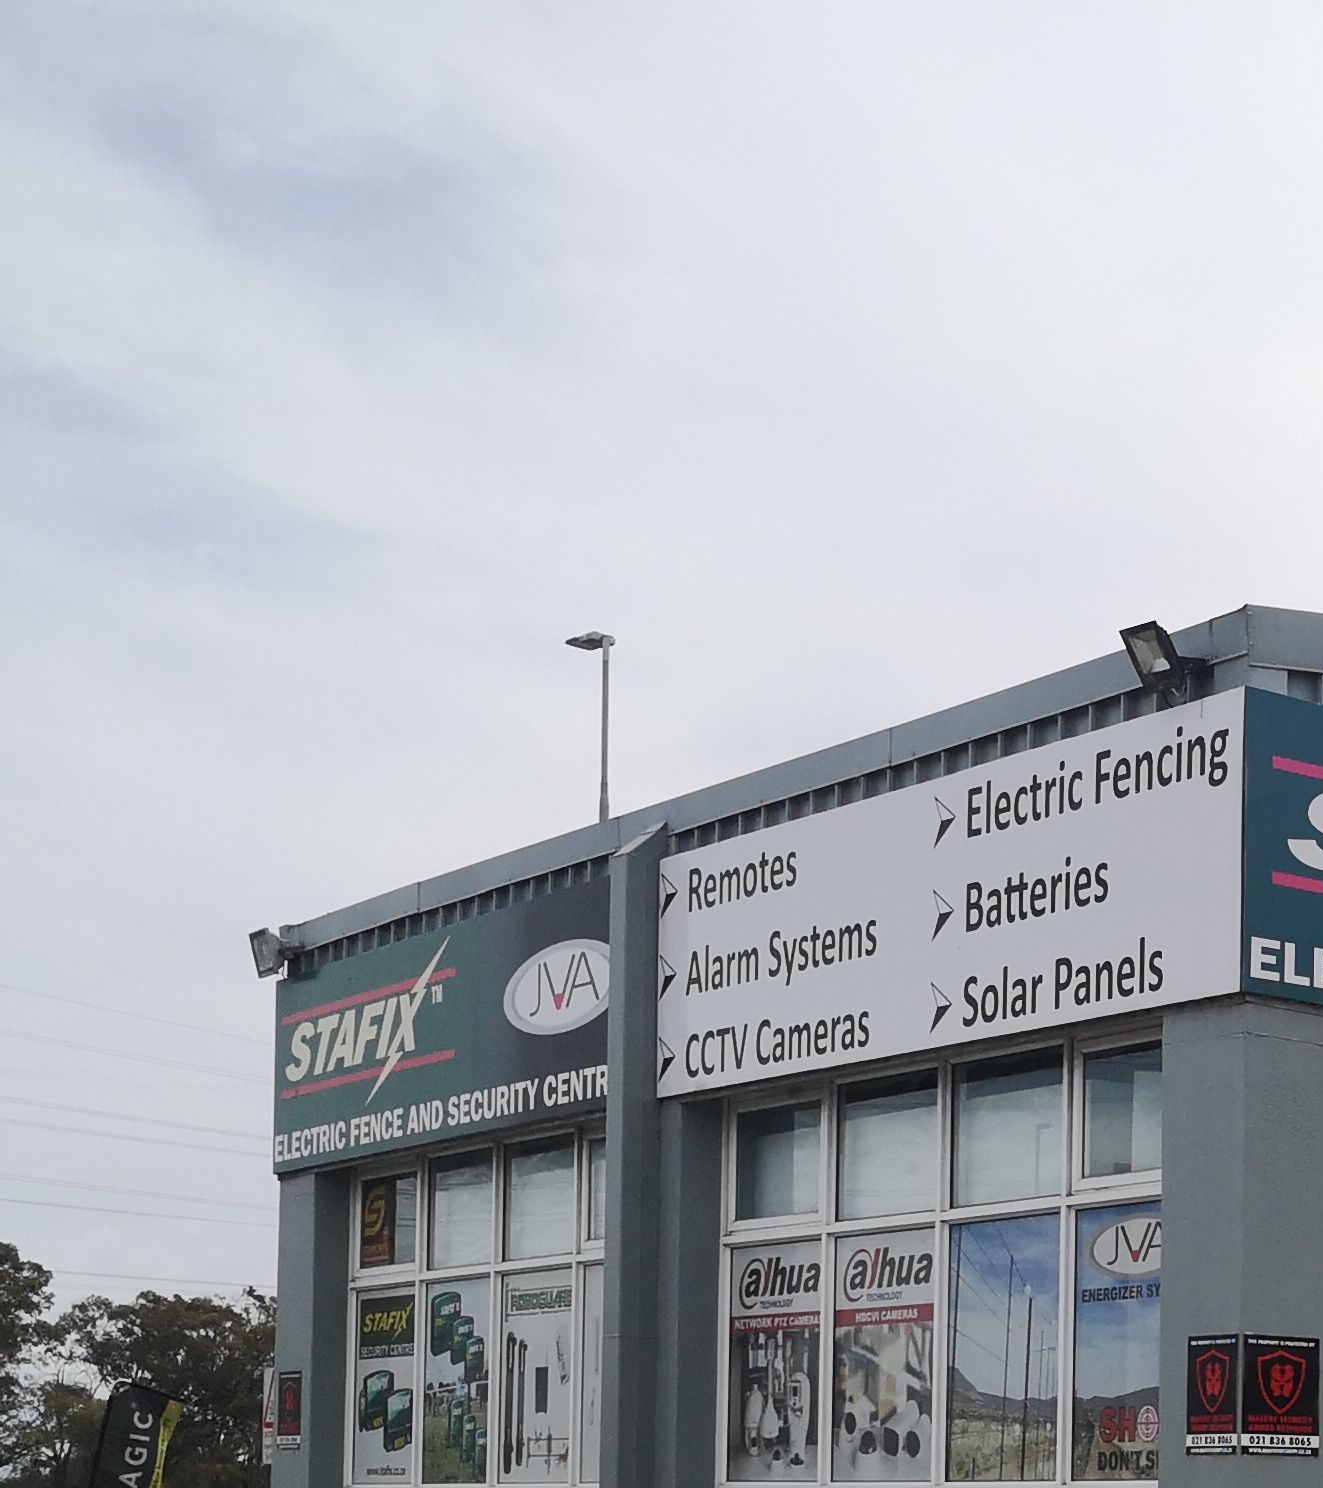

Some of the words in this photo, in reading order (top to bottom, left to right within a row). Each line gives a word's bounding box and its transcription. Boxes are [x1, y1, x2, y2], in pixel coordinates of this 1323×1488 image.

[967, 761, 1083, 839] Electric
[1095, 726, 1230, 806] Fencing
[688, 849, 798, 913] Remotes
[966, 857, 1109, 933] Batteries
[530, 951, 600, 1018] JVA
[686, 944, 759, 996] Alarm
[768, 917, 878, 988] Systems
[963, 966, 1043, 1028] Solar
[1055, 936, 1164, 1008] Panels
[285, 972, 436, 1087] STAFIX
[685, 1025, 748, 1079] CCTV
[756, 1008, 870, 1063] Cameras
[274, 1121, 347, 1163] ELECTRIC
[350, 1107, 404, 1147] FENCE
[407, 1099, 444, 1136] AND
[447, 1079, 540, 1127] SECURITY
[543, 1064, 609, 1107] CENTR
[364, 1307, 410, 1335] STAFIX
[735, 1317, 772, 1330] NETWORK
[881, 1308, 918, 1321] CAMERAS
[1081, 1284, 1144, 1303] ENERGIZER
[1099, 1405, 1159, 1443] SHO
[1250, 1436, 1266, 1445] 021
[1269, 1436, 1286, 1446] 836
[1289, 1437, 1312, 1446] 8065
[1097, 1450, 1143, 1471] DON'T
